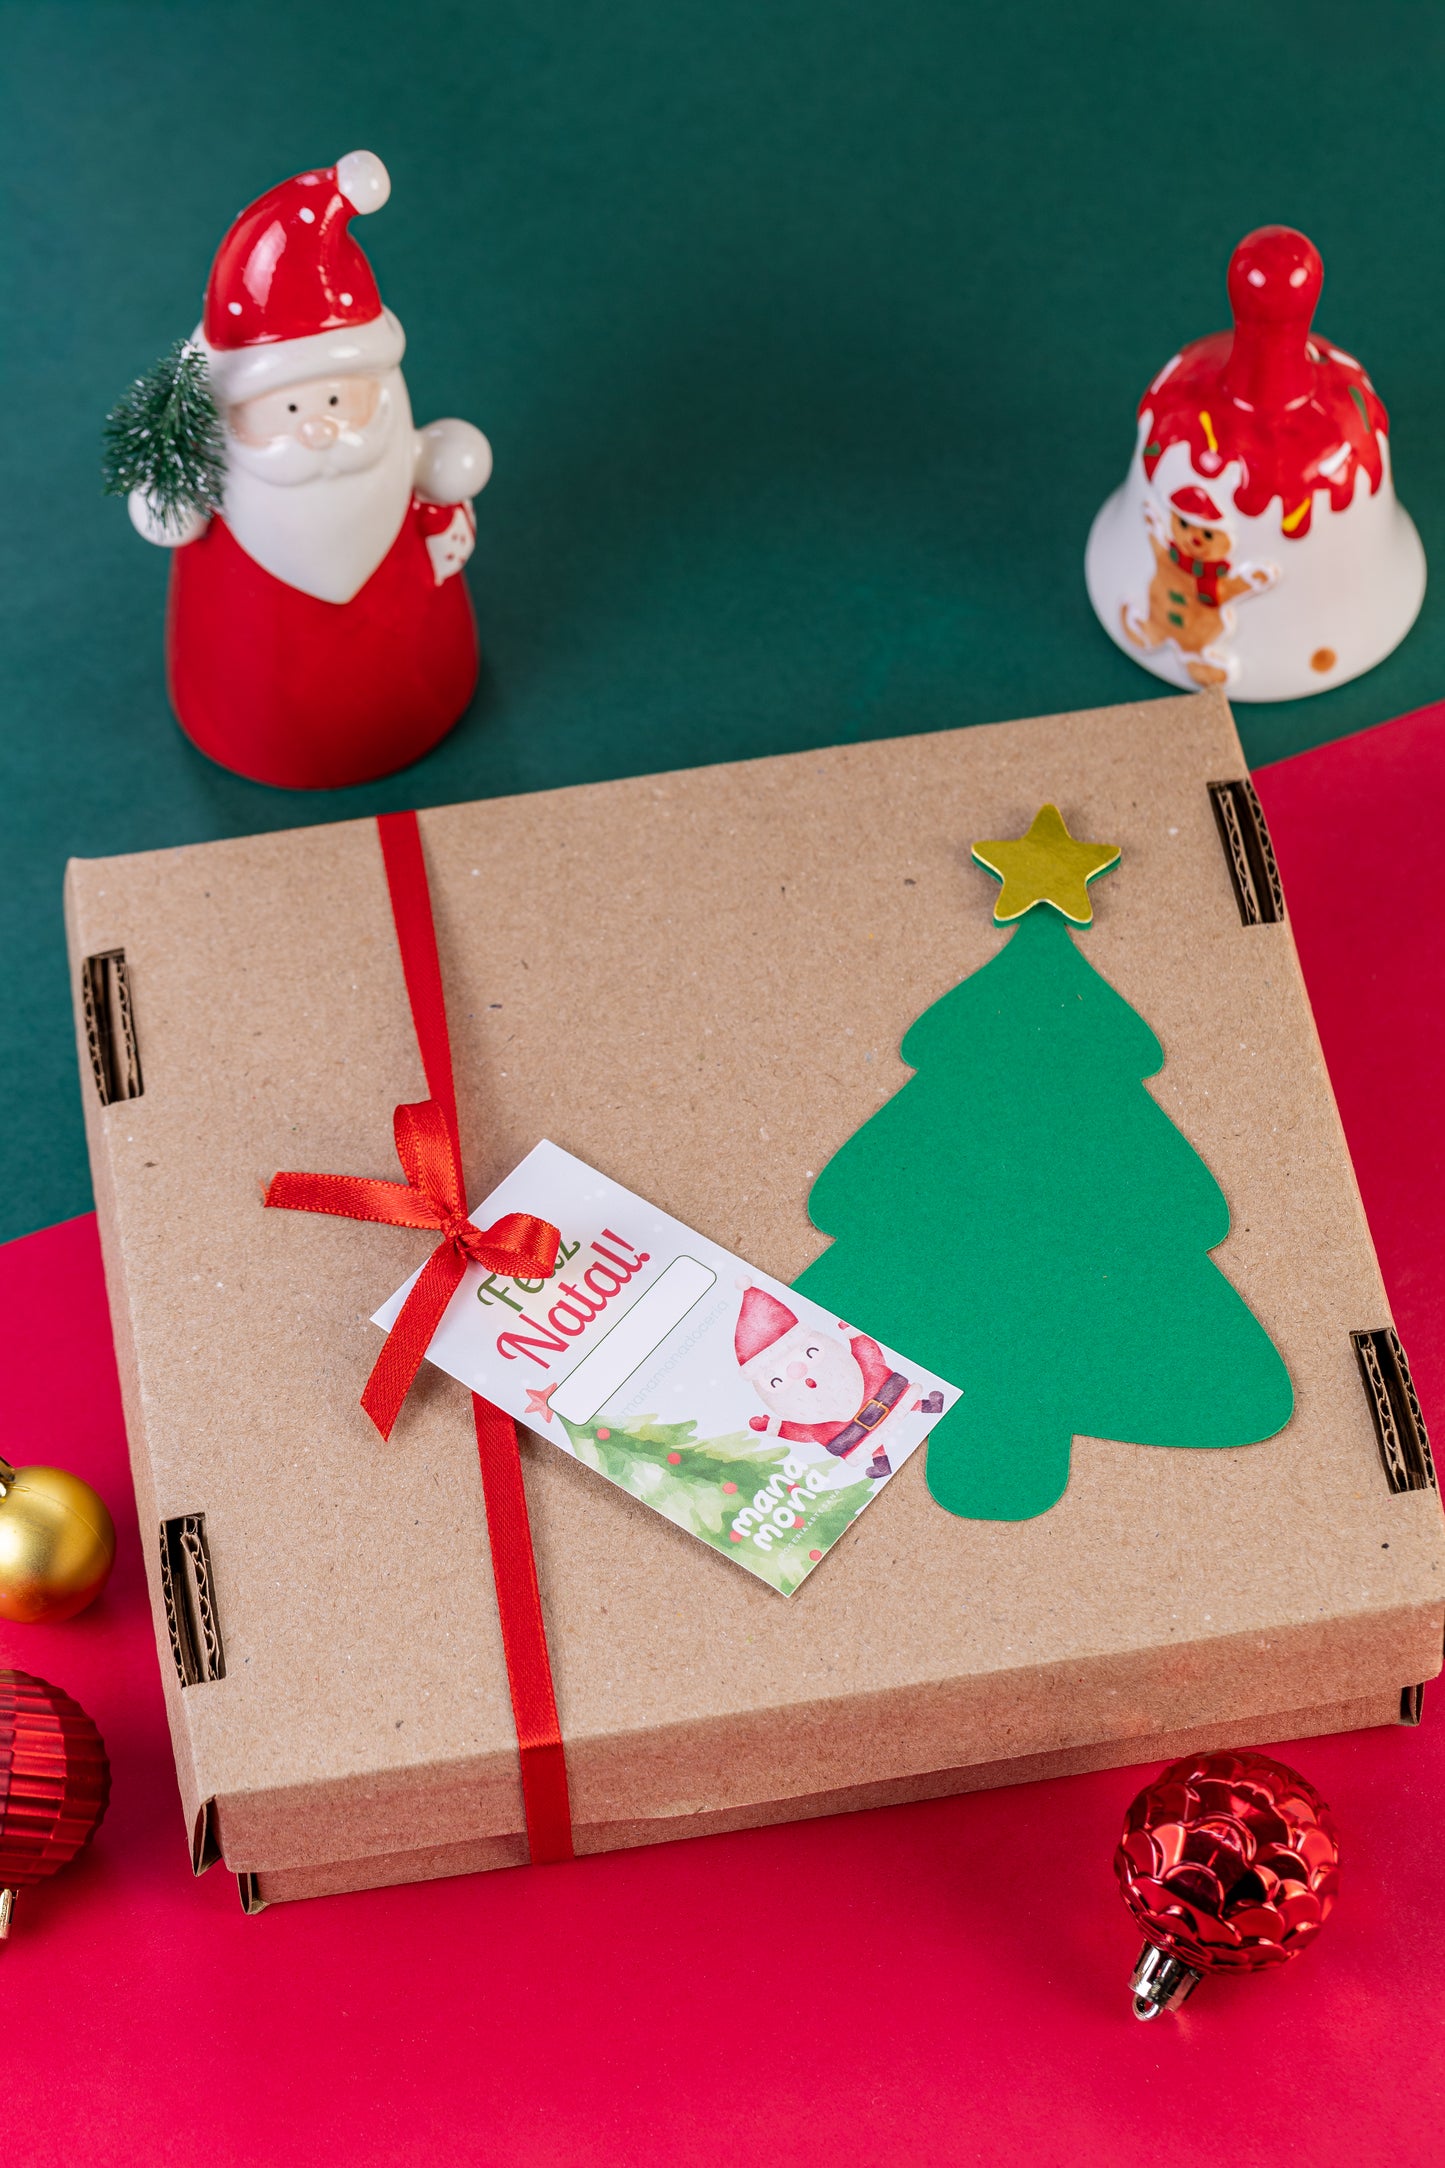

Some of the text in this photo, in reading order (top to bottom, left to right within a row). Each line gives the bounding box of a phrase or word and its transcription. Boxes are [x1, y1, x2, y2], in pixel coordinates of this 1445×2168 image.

[477, 1239, 581, 1312] Fez
[496, 1228, 650, 1369] Natal!
[732, 1457, 808, 1537] mana
[753, 1469, 829, 1551] mona
